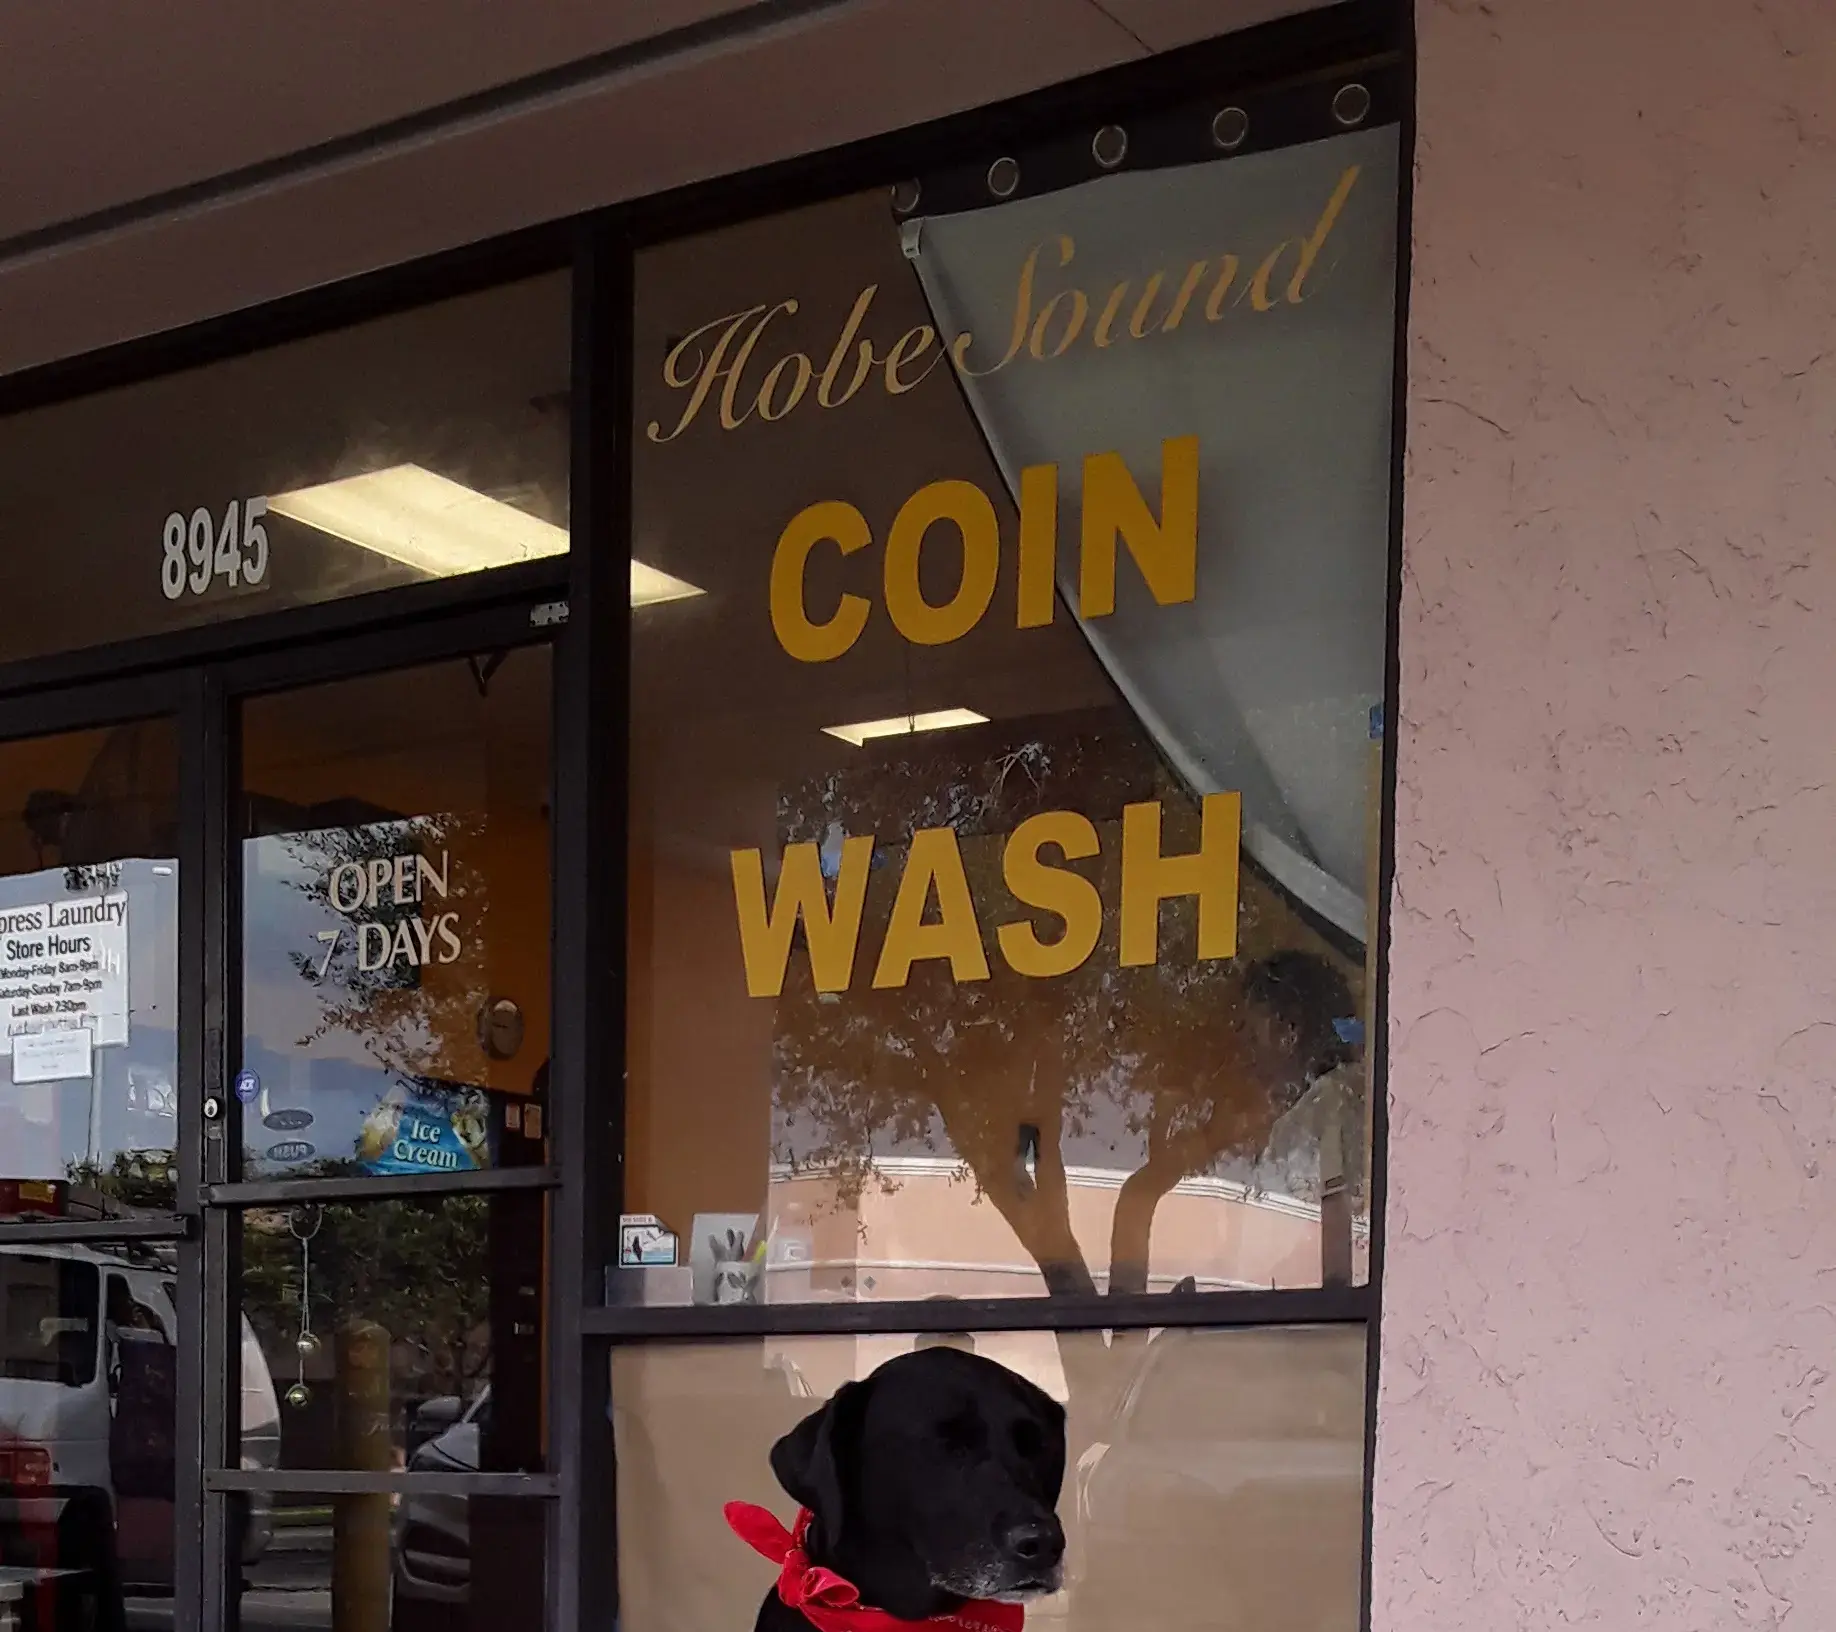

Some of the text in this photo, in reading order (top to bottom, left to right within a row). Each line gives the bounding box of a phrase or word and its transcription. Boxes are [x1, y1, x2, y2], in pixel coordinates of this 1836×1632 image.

[647, 165, 1361, 443] Hobe Sound
[161, 496, 270, 599] 8945
[770, 435, 1198, 662] COIN
[47, 895, 126, 927] Laundry
[328, 849, 449, 913] OPEN
[731, 791, 1242, 998] WASH
[6, 934, 92, 961] Store Hours
[317, 911, 462, 977] 7 DAYS
[393, 1139, 458, 1170] Cream
[410, 1119, 441, 1143] Ice
